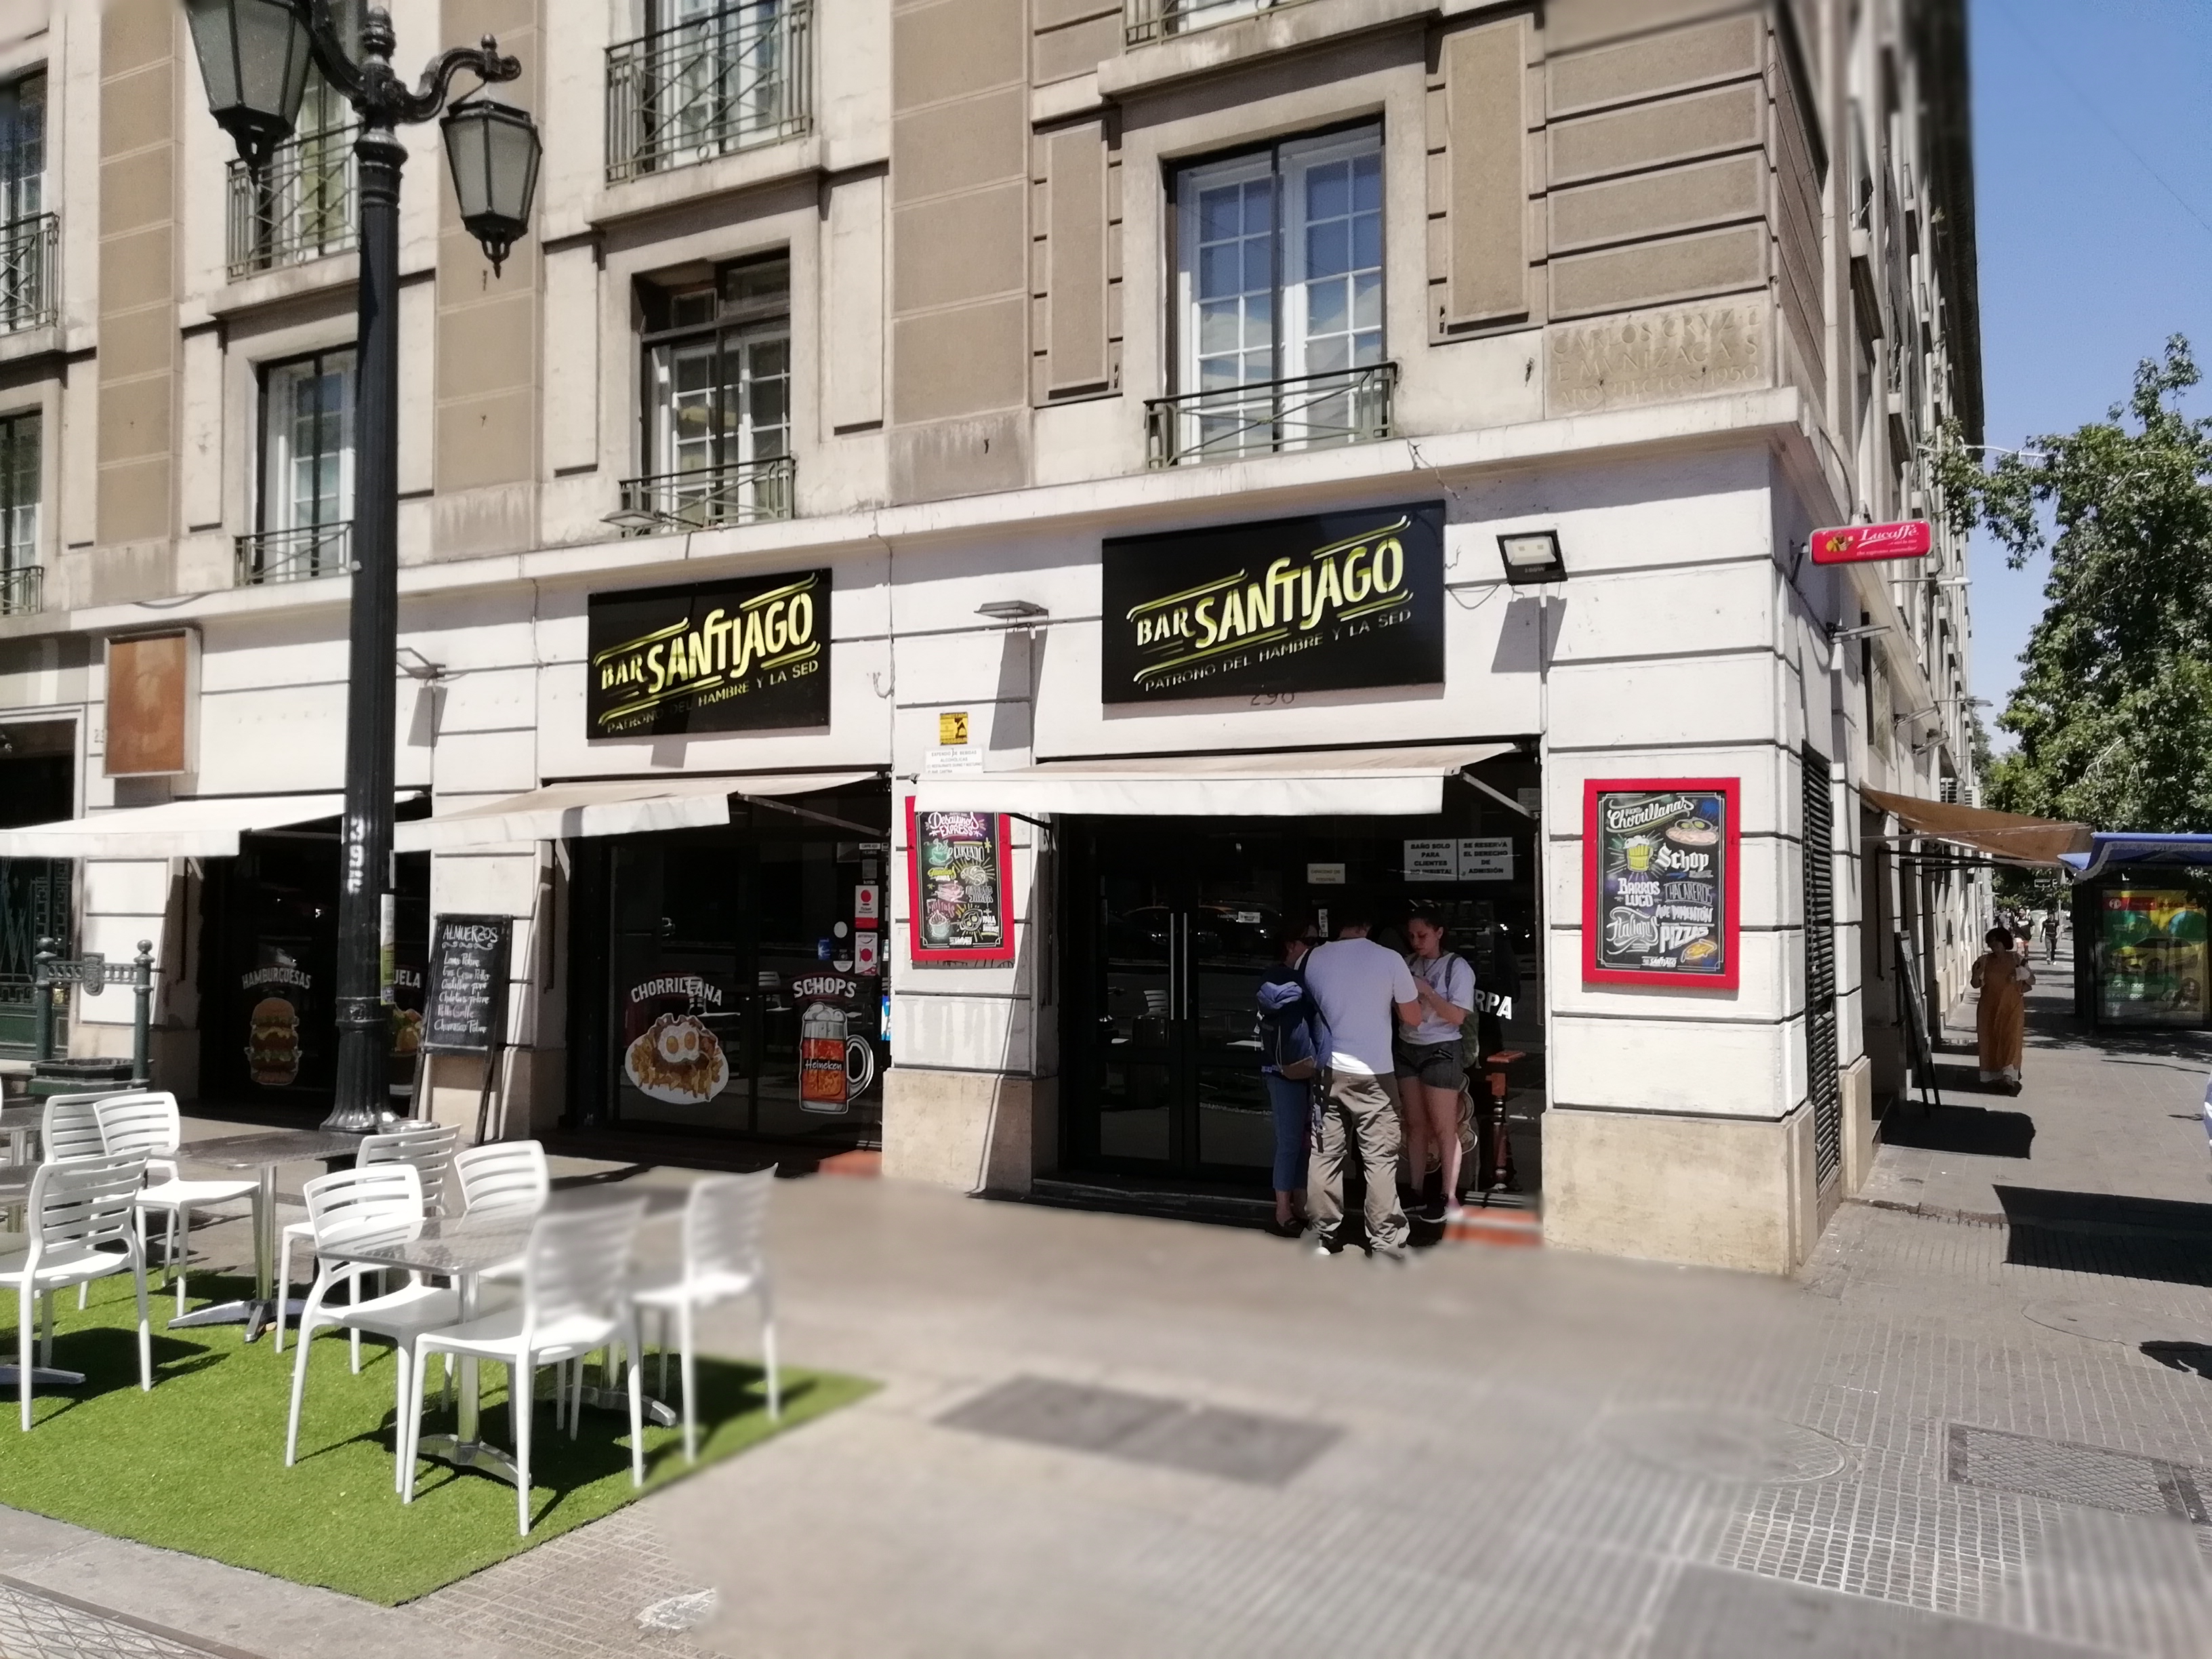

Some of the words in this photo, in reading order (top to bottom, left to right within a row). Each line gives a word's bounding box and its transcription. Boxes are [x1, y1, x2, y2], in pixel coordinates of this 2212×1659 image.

[1136, 605, 1195, 647] BAR
[1194, 537, 1404, 649] SANTIAGO
[601, 653, 649, 691] BAR
[648, 592, 813, 694] SANTIAGO
[1145, 663, 1216, 693] PATRONO
[1223, 654, 1252, 673] DEL
[1258, 632, 1324, 663] HAMBRE
[1332, 626, 1343, 641] Y
[1349, 619, 1371, 638] LA
[1378, 609, 1412, 629] SED
[670, 701, 693, 714] DEL
[698, 680, 750, 708] HAMBRE
[756, 676, 764, 689] Y
[769, 670, 787, 687] LA
[792, 659, 819, 679] SED
[1607, 796, 1695, 830] Chorrillanas
[939, 825, 974, 838] EXPRESS
[1474, 840, 1508, 848] RESERVA
[1655, 842, 1710, 873] Schop
[1617, 878, 1661, 895] BARROS
[1625, 894, 1654, 907] LUCO
[443, 924, 499, 944] ALMUERZOS
[1659, 926, 1710, 954] PIZZAS
[242, 967, 312, 989] HAMBURGUESAS
[792, 977, 857, 999] SCHOPS
[630, 976, 723, 1006] CHORRILLANA
[804, 1060, 842, 1071] Heineken
